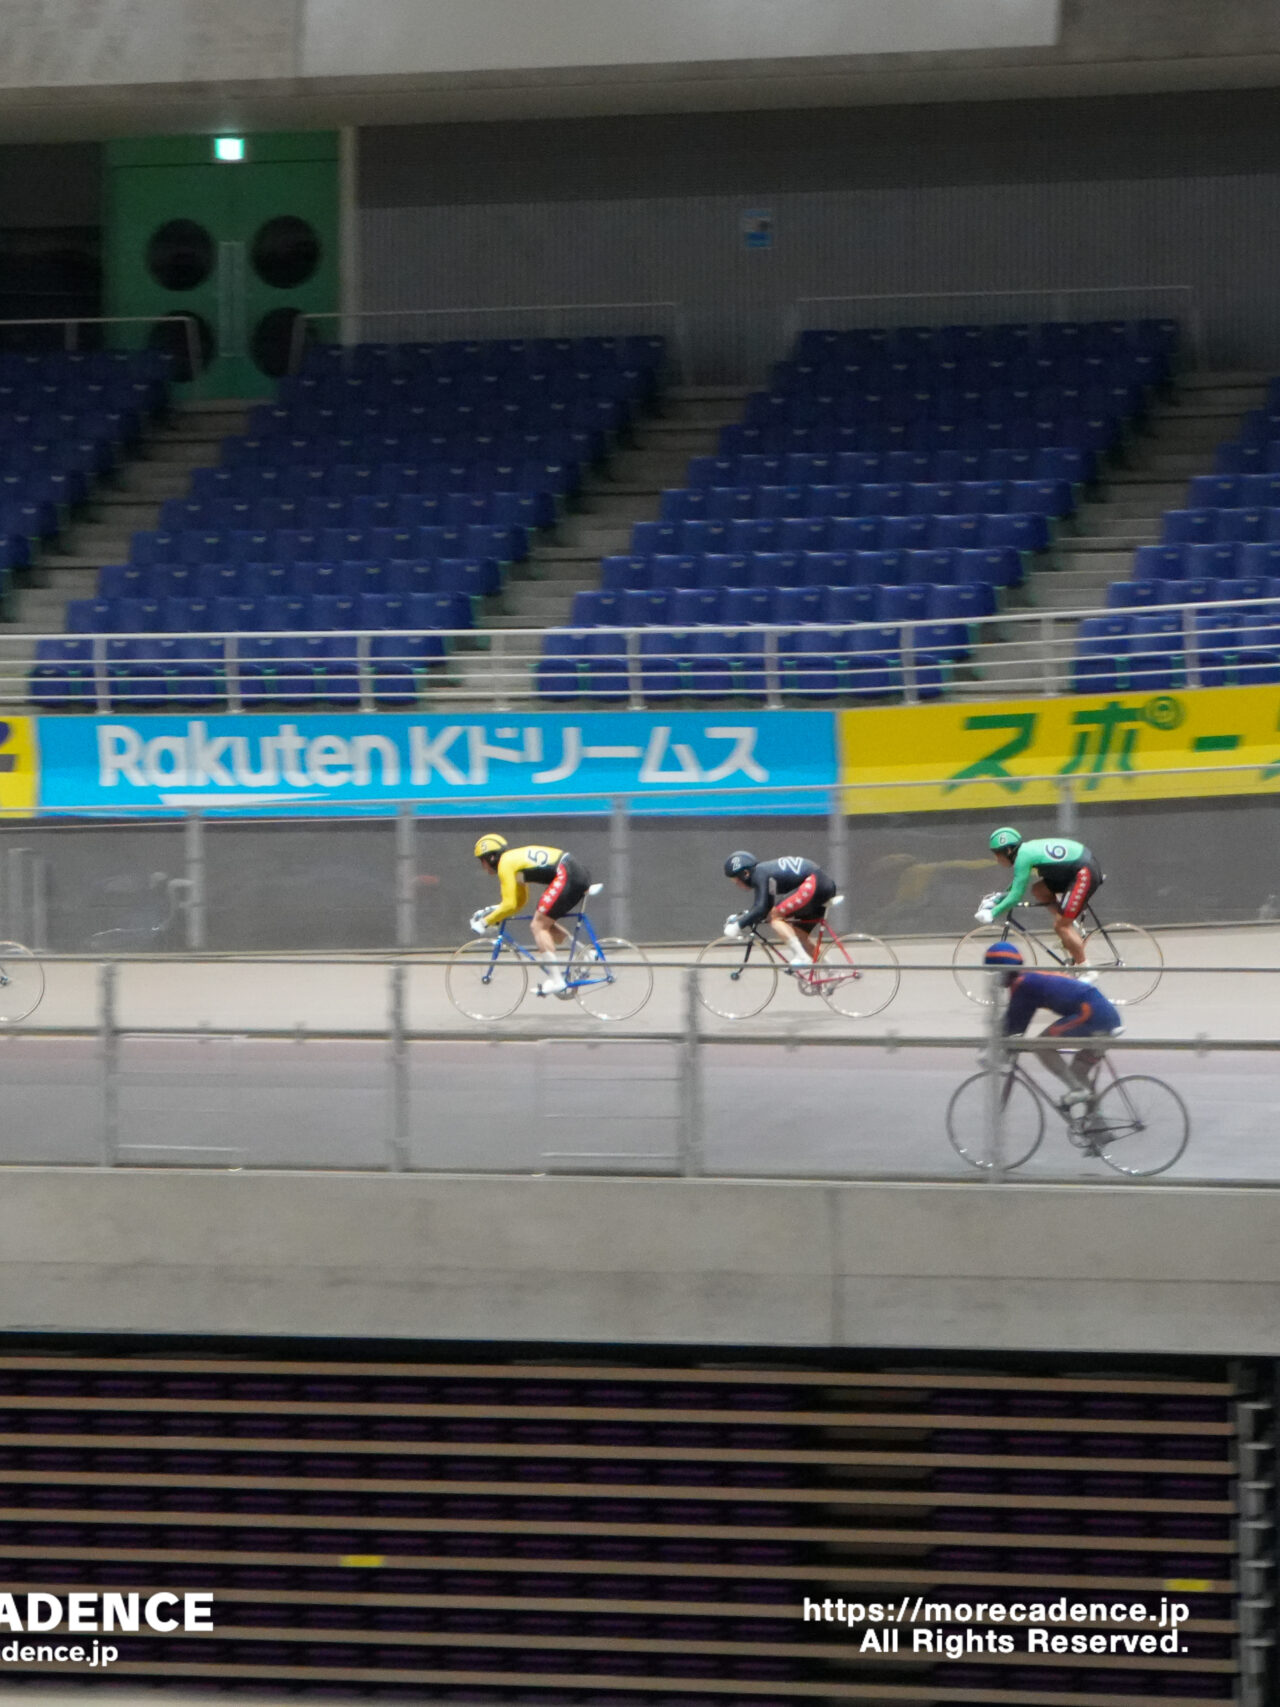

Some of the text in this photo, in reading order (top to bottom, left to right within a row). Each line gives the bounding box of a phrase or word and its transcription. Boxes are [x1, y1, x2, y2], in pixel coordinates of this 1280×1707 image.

[97, 721, 402, 788] Rakuten
[942, 696, 1280, 794] スポー
[526, 848, 550, 867] 5
[1044, 843, 1068, 862] 6
[777, 855, 804, 875] 2
